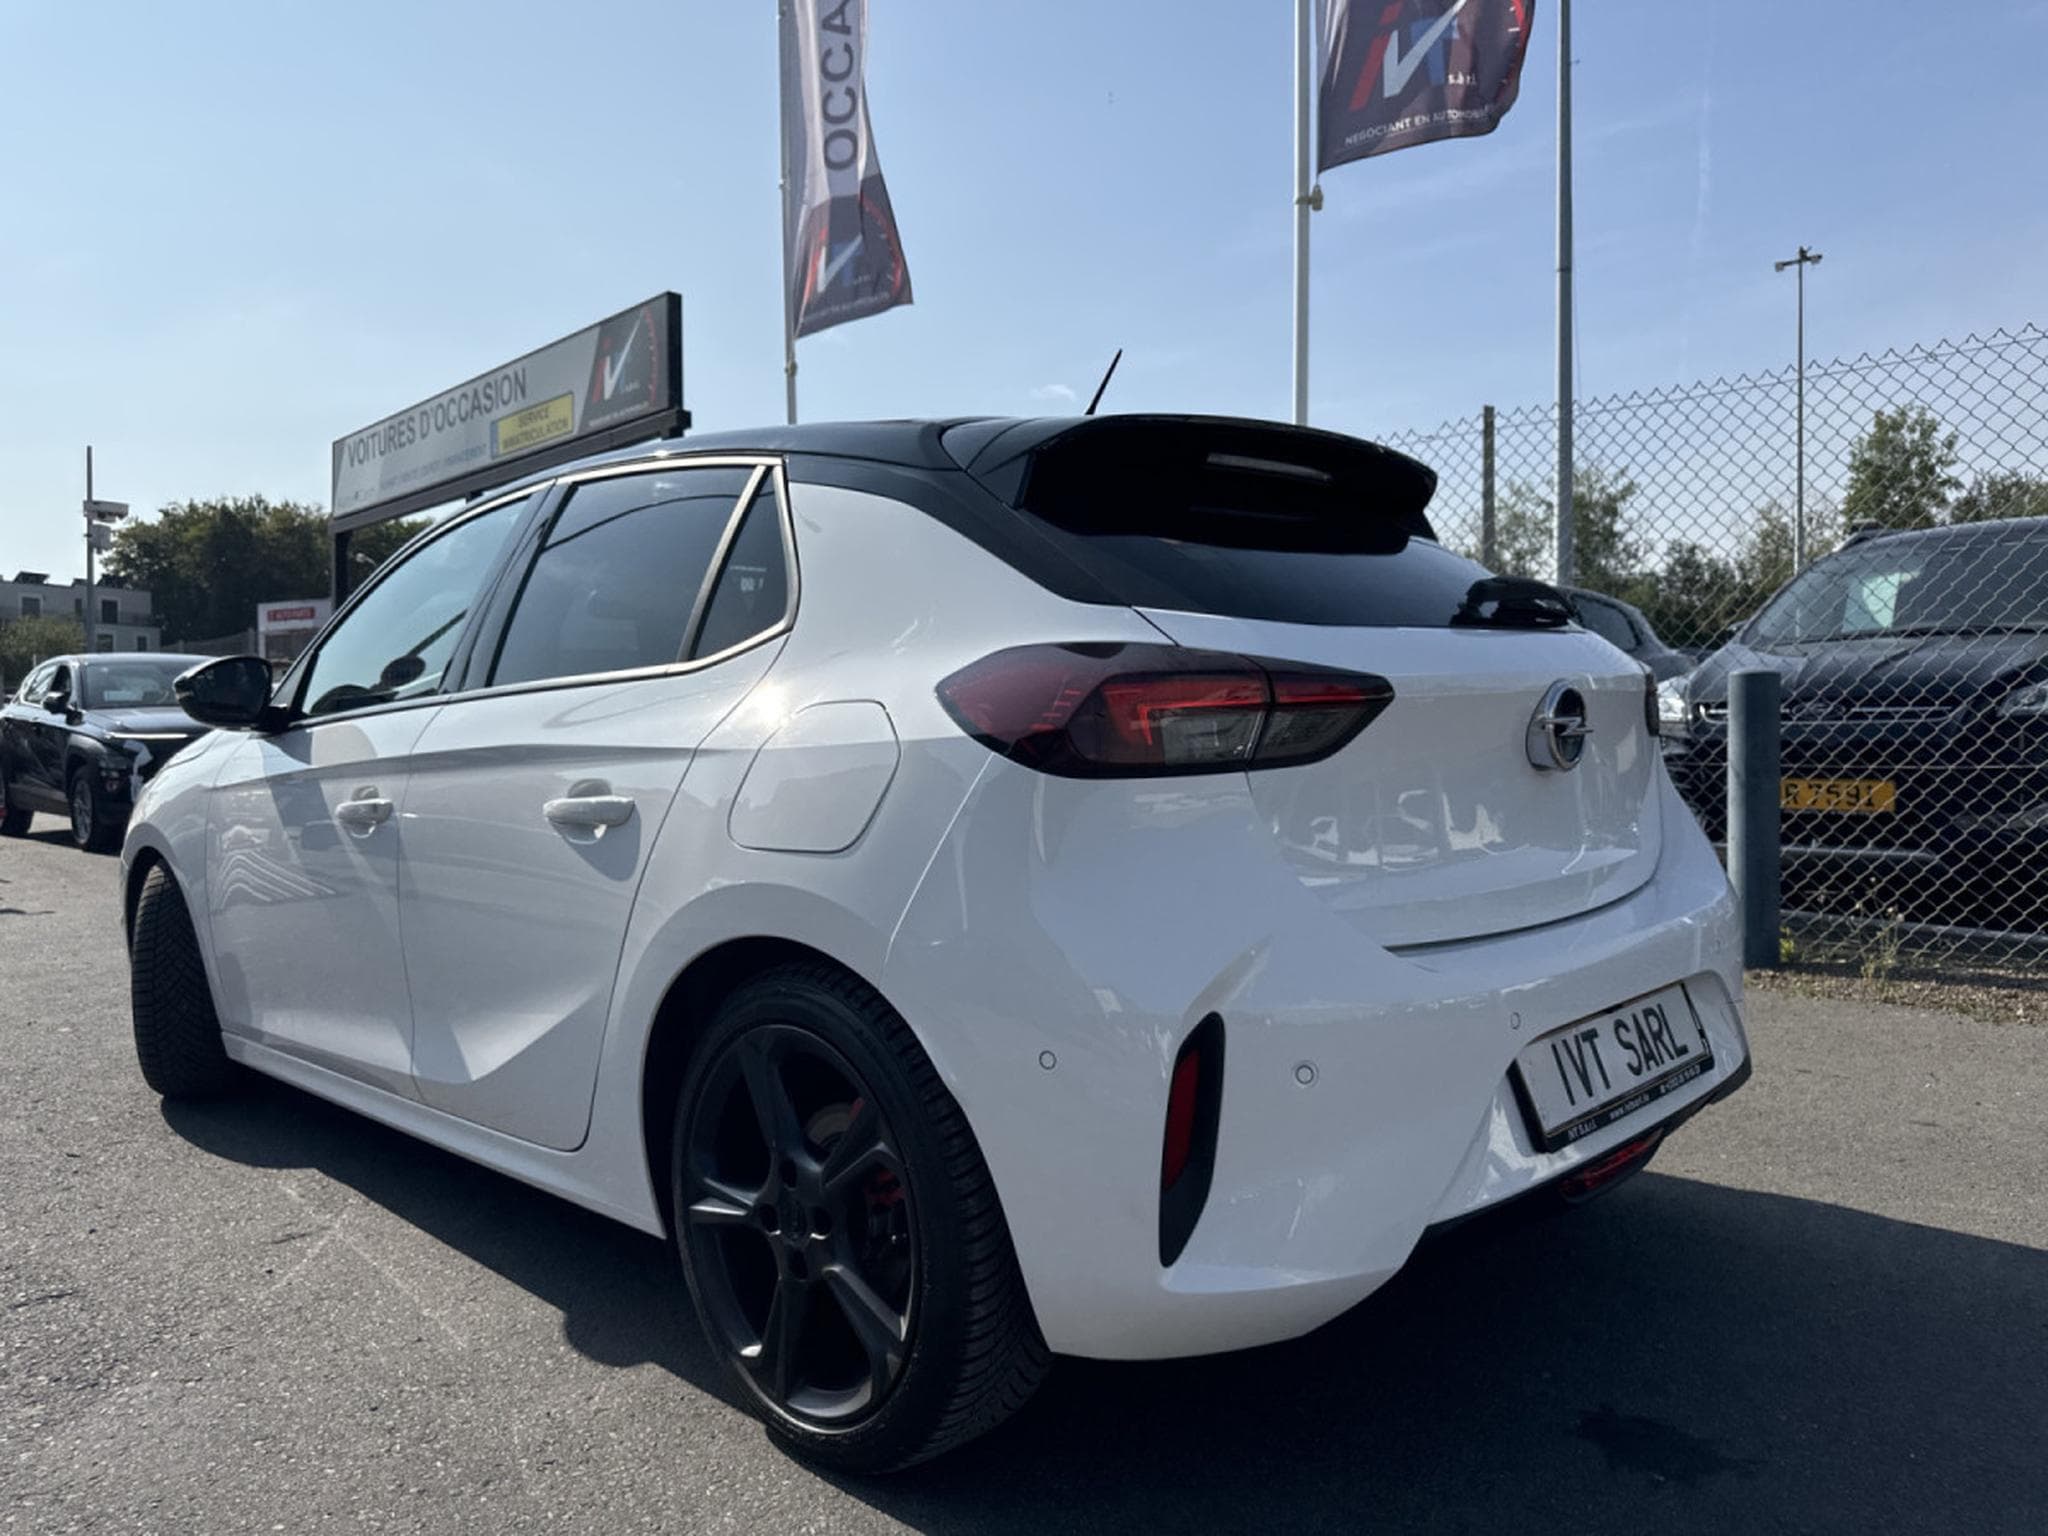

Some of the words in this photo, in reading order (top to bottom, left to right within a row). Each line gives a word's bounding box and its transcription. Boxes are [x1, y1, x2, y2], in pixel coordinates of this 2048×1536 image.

[1414, 114, 1431, 127] EN
[347, 415, 416, 468] VOITURES
[419, 369, 526, 440] D'OCCASION
[1551, 1027, 1611, 1106] IVT
[1613, 1003, 1689, 1077] SARL
